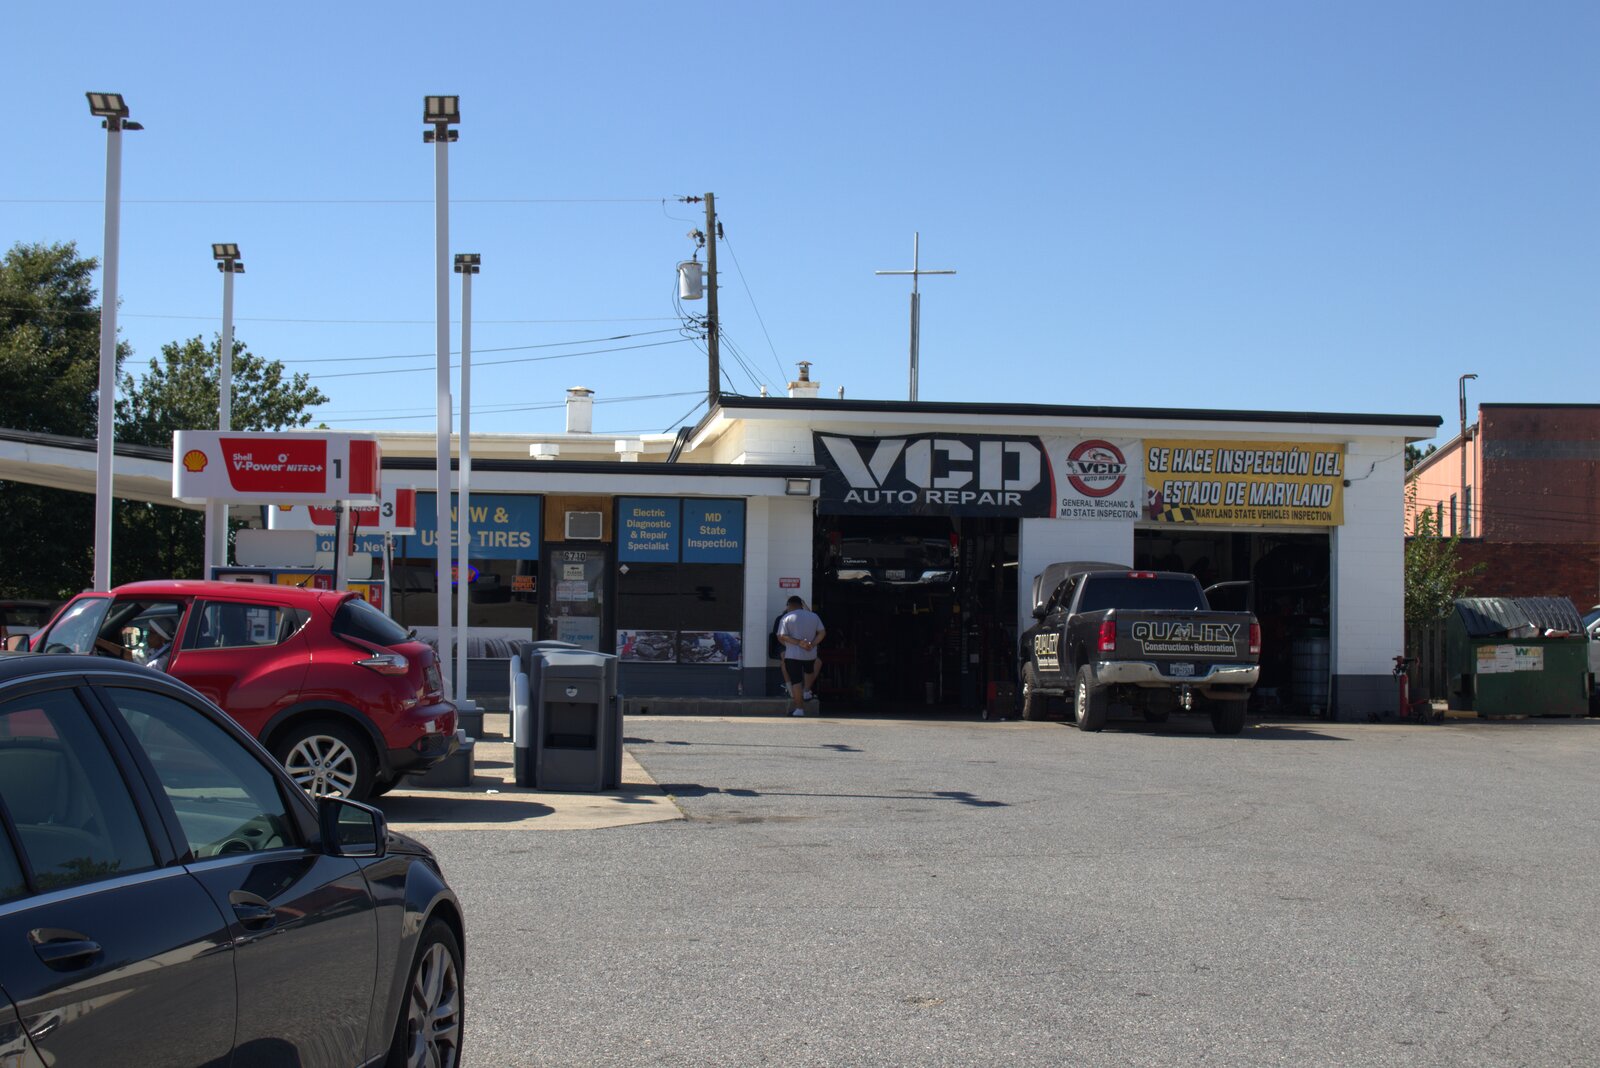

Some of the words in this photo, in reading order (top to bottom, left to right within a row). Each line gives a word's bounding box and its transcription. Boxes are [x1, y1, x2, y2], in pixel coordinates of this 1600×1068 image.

[233, 453, 253, 461] Shell
[1149, 447, 1170, 472] SE
[1172, 448, 1214, 473] HACE
[1215, 447, 1310, 475] INSPECCIÓN
[1312, 452, 1341, 476] DEL
[233, 461, 283, 472] V-Power
[332, 458, 342, 479] 1
[820, 436, 1042, 491] VCD
[1078, 462, 1121, 474] VCD
[844, 490, 917, 504] AUTO
[925, 491, 1022, 506] REPAIR
[1163, 480, 1222, 505] ESTADO
[1224, 482, 1247, 506] DE
[1248, 482, 1333, 508] MARYLAND
[1062, 498, 1093, 507] GENERAL
[1094, 500, 1128, 508] MECHANIC
[382, 502, 394, 518] 3
[450, 506, 488, 523] NW
[493, 507, 509, 523] &
[633, 508, 665, 517] Electric
[1061, 508, 1072, 517] MD
[1073, 509, 1095, 517] STATE
[1097, 509, 1138, 518] INSPECTION
[1195, 508, 1233, 518] MARYLAND
[1234, 509, 1257, 519] STATE
[1257, 509, 1290, 520] VEHICLES
[1291, 510, 1332, 521] INSPECTION
[705, 512, 722, 522] MD
[626, 519, 671, 529] Diagnostic
[630, 530, 637, 539] &
[640, 530, 667, 540] Repair
[699, 525, 727, 535] State
[421, 530, 471, 547] UE
[477, 530, 531, 548] TIRES
[687, 538, 738, 549] Inspection
[627, 541, 670, 551] Specialist
[1132, 622, 1240, 641] QUALITY
[1144, 642, 1190, 652] Construction
[1194, 643, 1234, 653] Restoration
